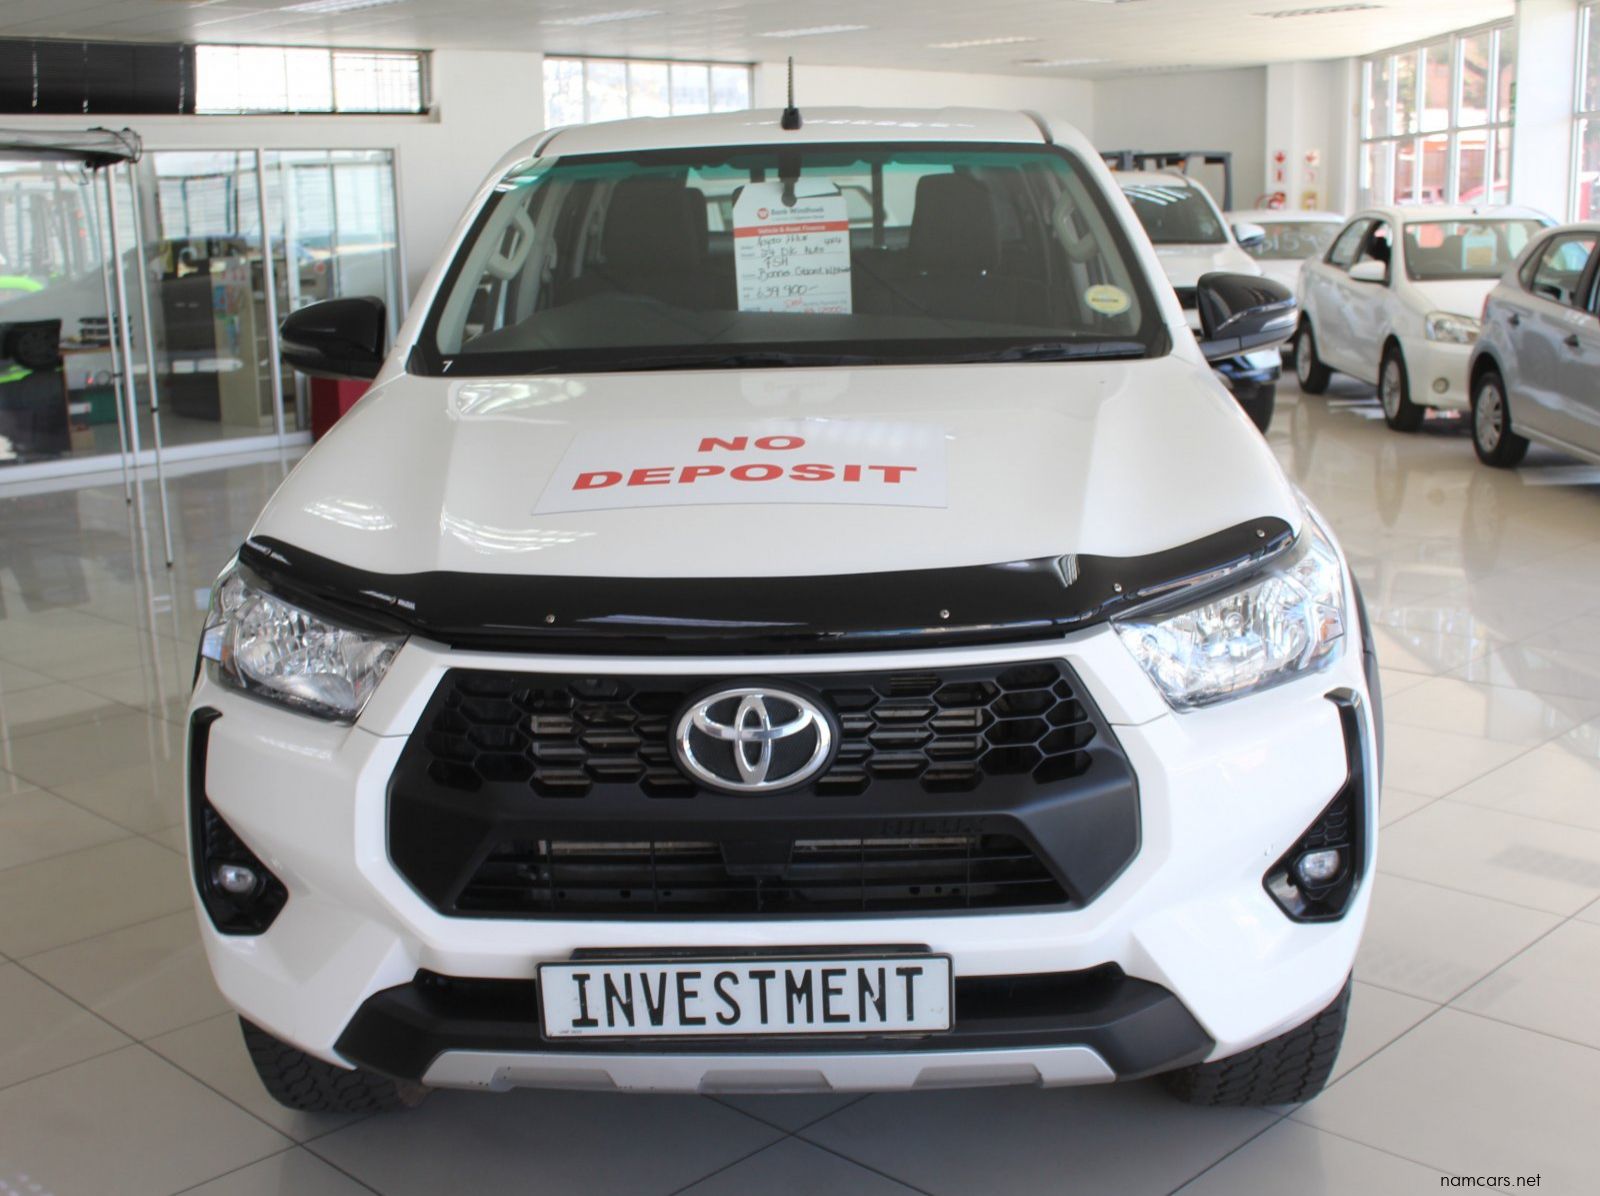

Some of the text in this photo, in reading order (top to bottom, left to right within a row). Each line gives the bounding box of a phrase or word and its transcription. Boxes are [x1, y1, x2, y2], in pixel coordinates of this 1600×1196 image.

[698, 435, 806, 452] NO
[571, 463, 917, 491] DEPOSIT
[571, 967, 923, 1028] INVESTMENT
